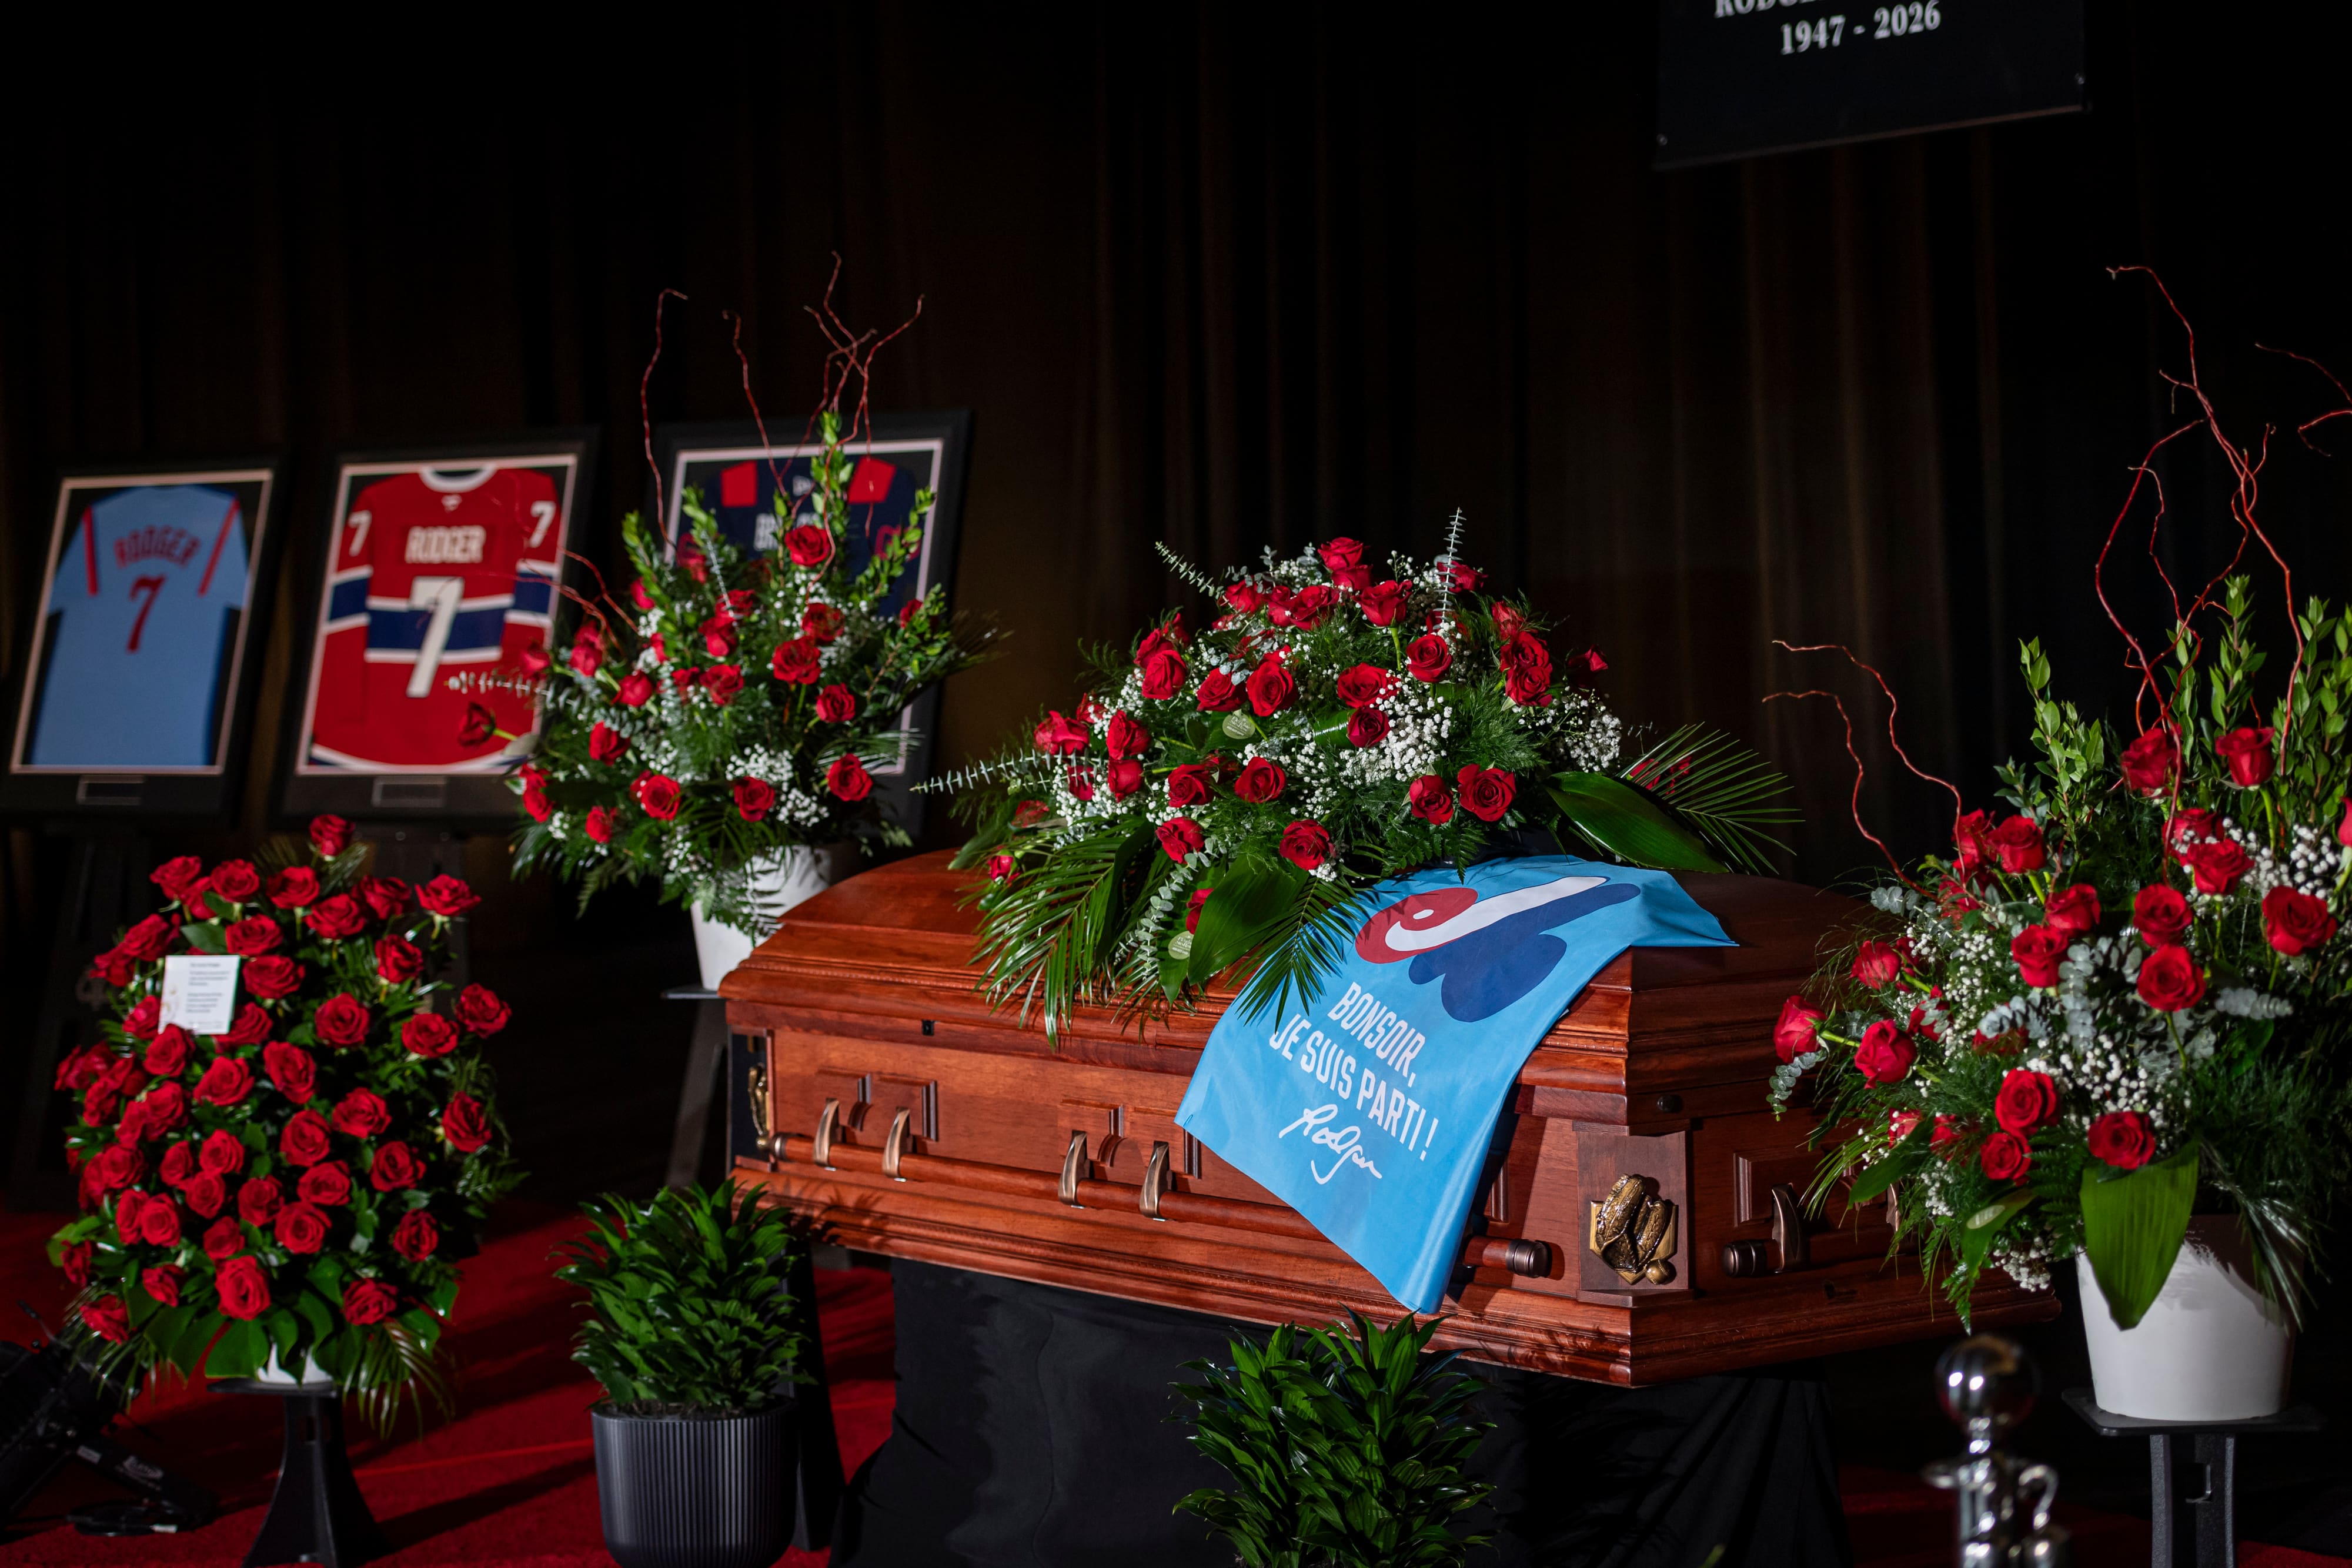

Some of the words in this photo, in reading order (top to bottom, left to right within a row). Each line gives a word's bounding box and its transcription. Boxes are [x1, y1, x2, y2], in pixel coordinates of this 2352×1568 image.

[1780, 15, 1846, 55] 1947
[1873, 0, 1941, 39] 2026
[113, 524, 201, 569] RODGER
[348, 509, 372, 557] 7
[405, 525, 487, 564] RODGER
[530, 500, 556, 549] 7
[126, 573, 167, 654] 7
[406, 575, 465, 698] 7
[1269, 1014, 1311, 1061] JE
[1300, 1030, 1356, 1099] SUIS
[1328, 982, 1425, 1088] BONSOIR,
